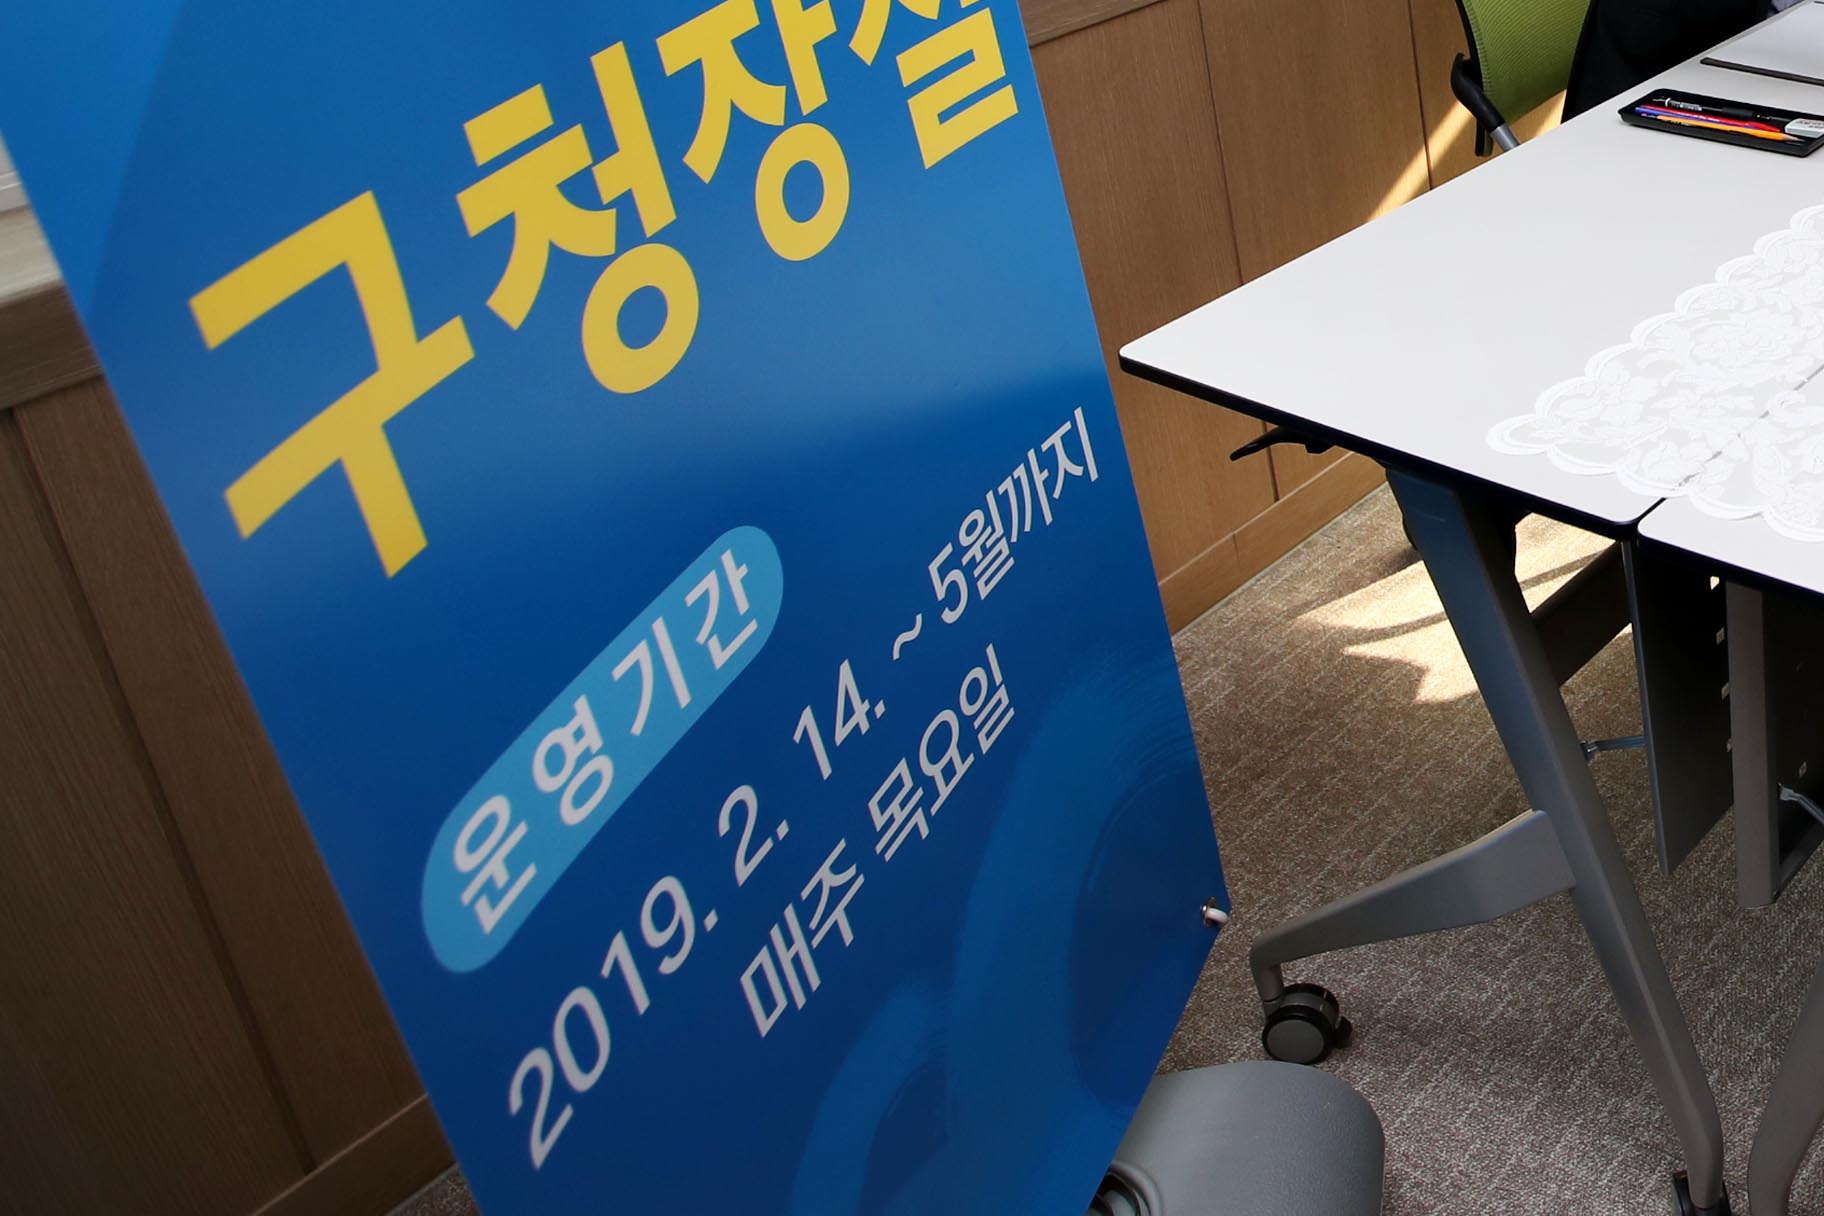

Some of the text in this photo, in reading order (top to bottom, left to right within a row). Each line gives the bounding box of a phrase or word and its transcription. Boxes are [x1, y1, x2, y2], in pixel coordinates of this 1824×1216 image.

[508, 875, 718, 1169] 2019.
[717, 785, 790, 887] 2.
[792, 659, 886, 781] 14.
[739, 643, 1016, 1038] 매주 목요일
